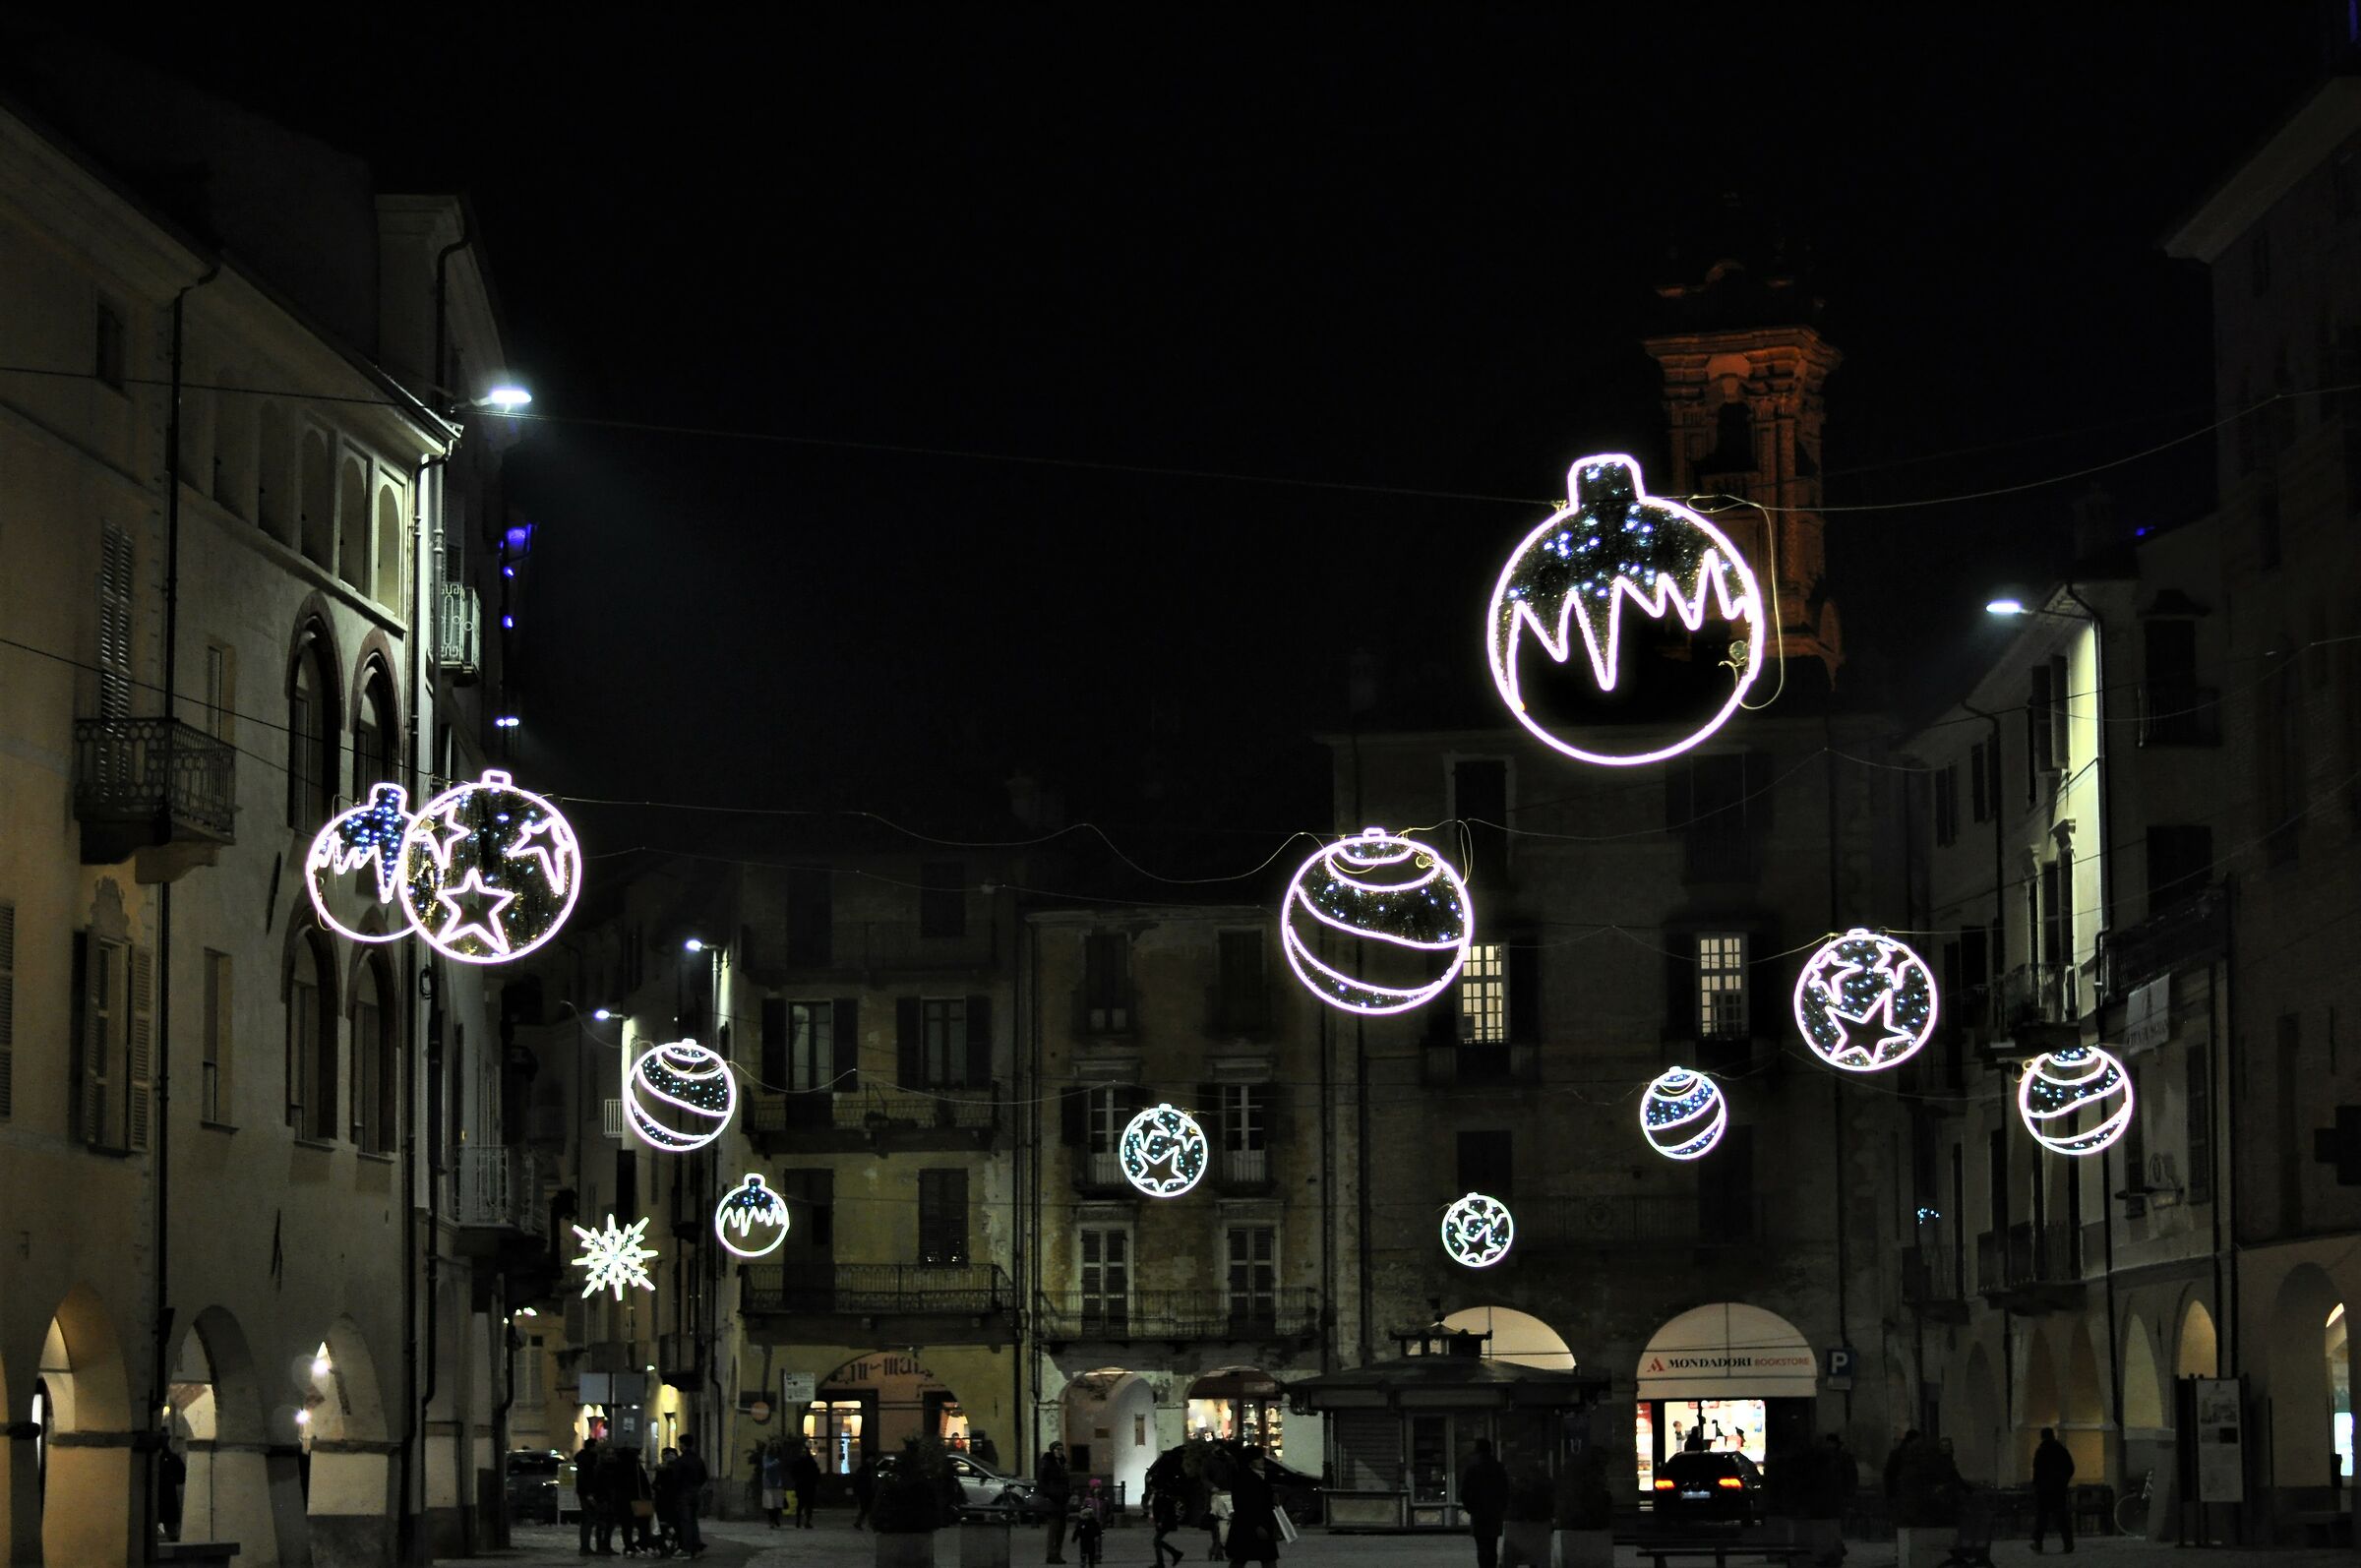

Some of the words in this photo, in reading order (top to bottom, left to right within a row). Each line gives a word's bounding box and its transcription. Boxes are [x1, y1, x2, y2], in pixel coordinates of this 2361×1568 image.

[1668, 1357, 1751, 1369] MONDADORI
[1755, 1357, 1810, 1367] BOOKSTORE
[1831, 1352, 1848, 1374] P
